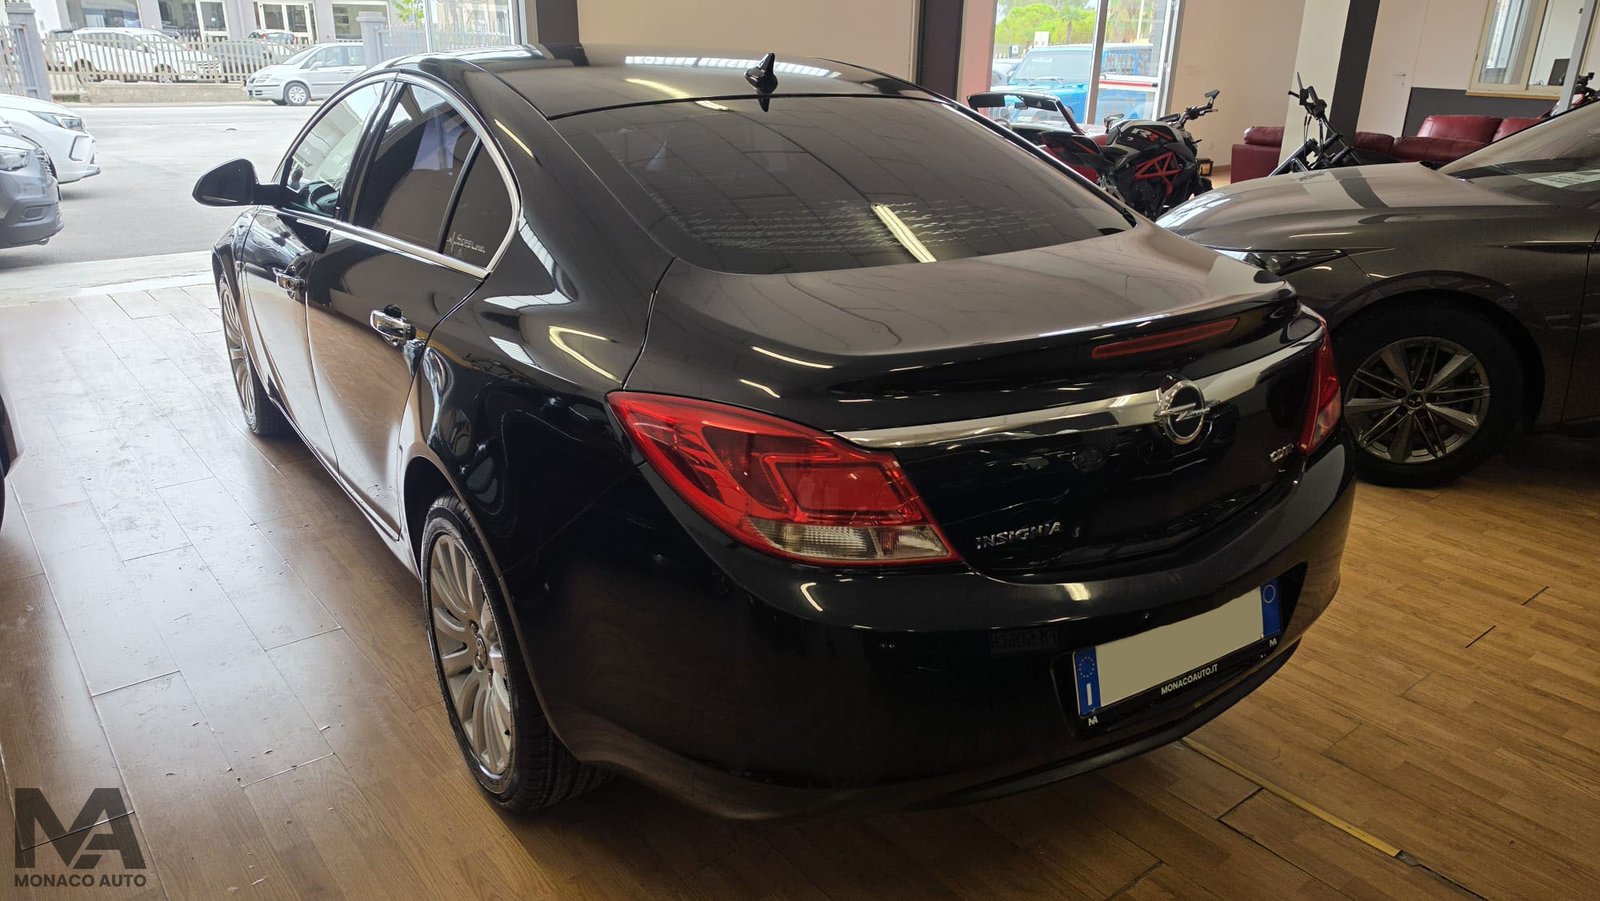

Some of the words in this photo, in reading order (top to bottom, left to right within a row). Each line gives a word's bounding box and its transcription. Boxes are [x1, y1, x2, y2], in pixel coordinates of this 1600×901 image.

[976, 521, 1061, 550] INSIGNIA
[1086, 682, 1093, 706] I
[1160, 663, 1219, 696] MONACOAUTO.IT
